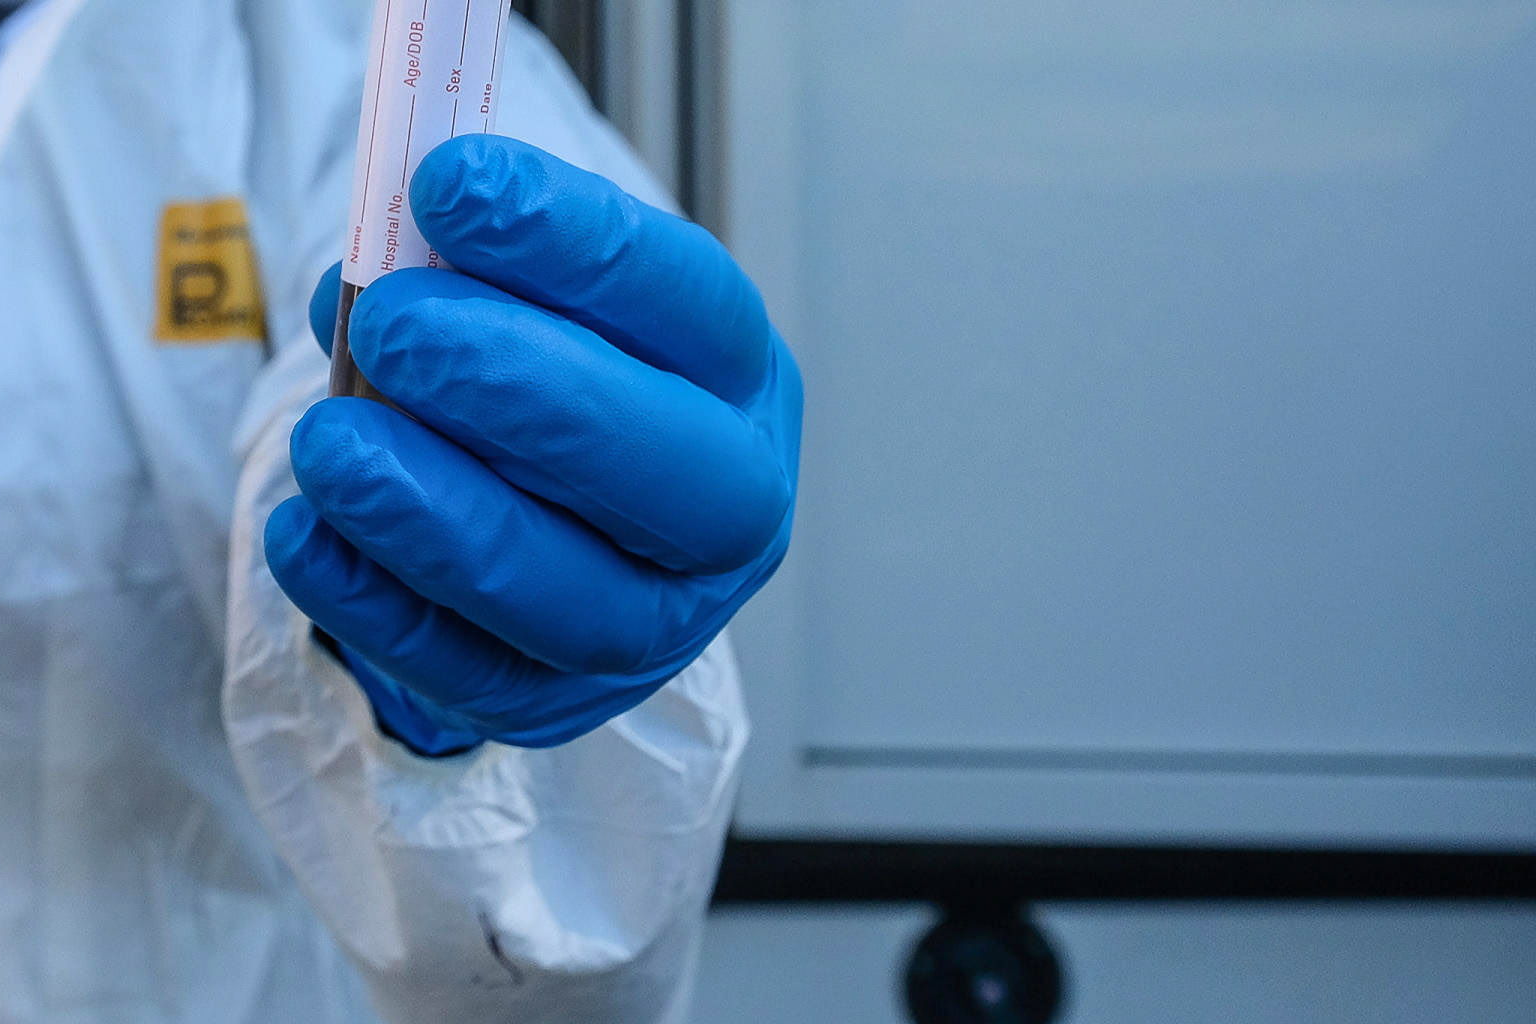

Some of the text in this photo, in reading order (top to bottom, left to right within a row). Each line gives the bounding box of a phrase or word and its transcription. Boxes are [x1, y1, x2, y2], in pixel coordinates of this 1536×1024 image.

[404, 21, 424, 88] Age/DOB
[446, 68, 462, 94] Sex
[480, 83, 492, 114] Date
[350, 226, 362, 264] Name
[380, 191, 403, 271] Hospital No.
